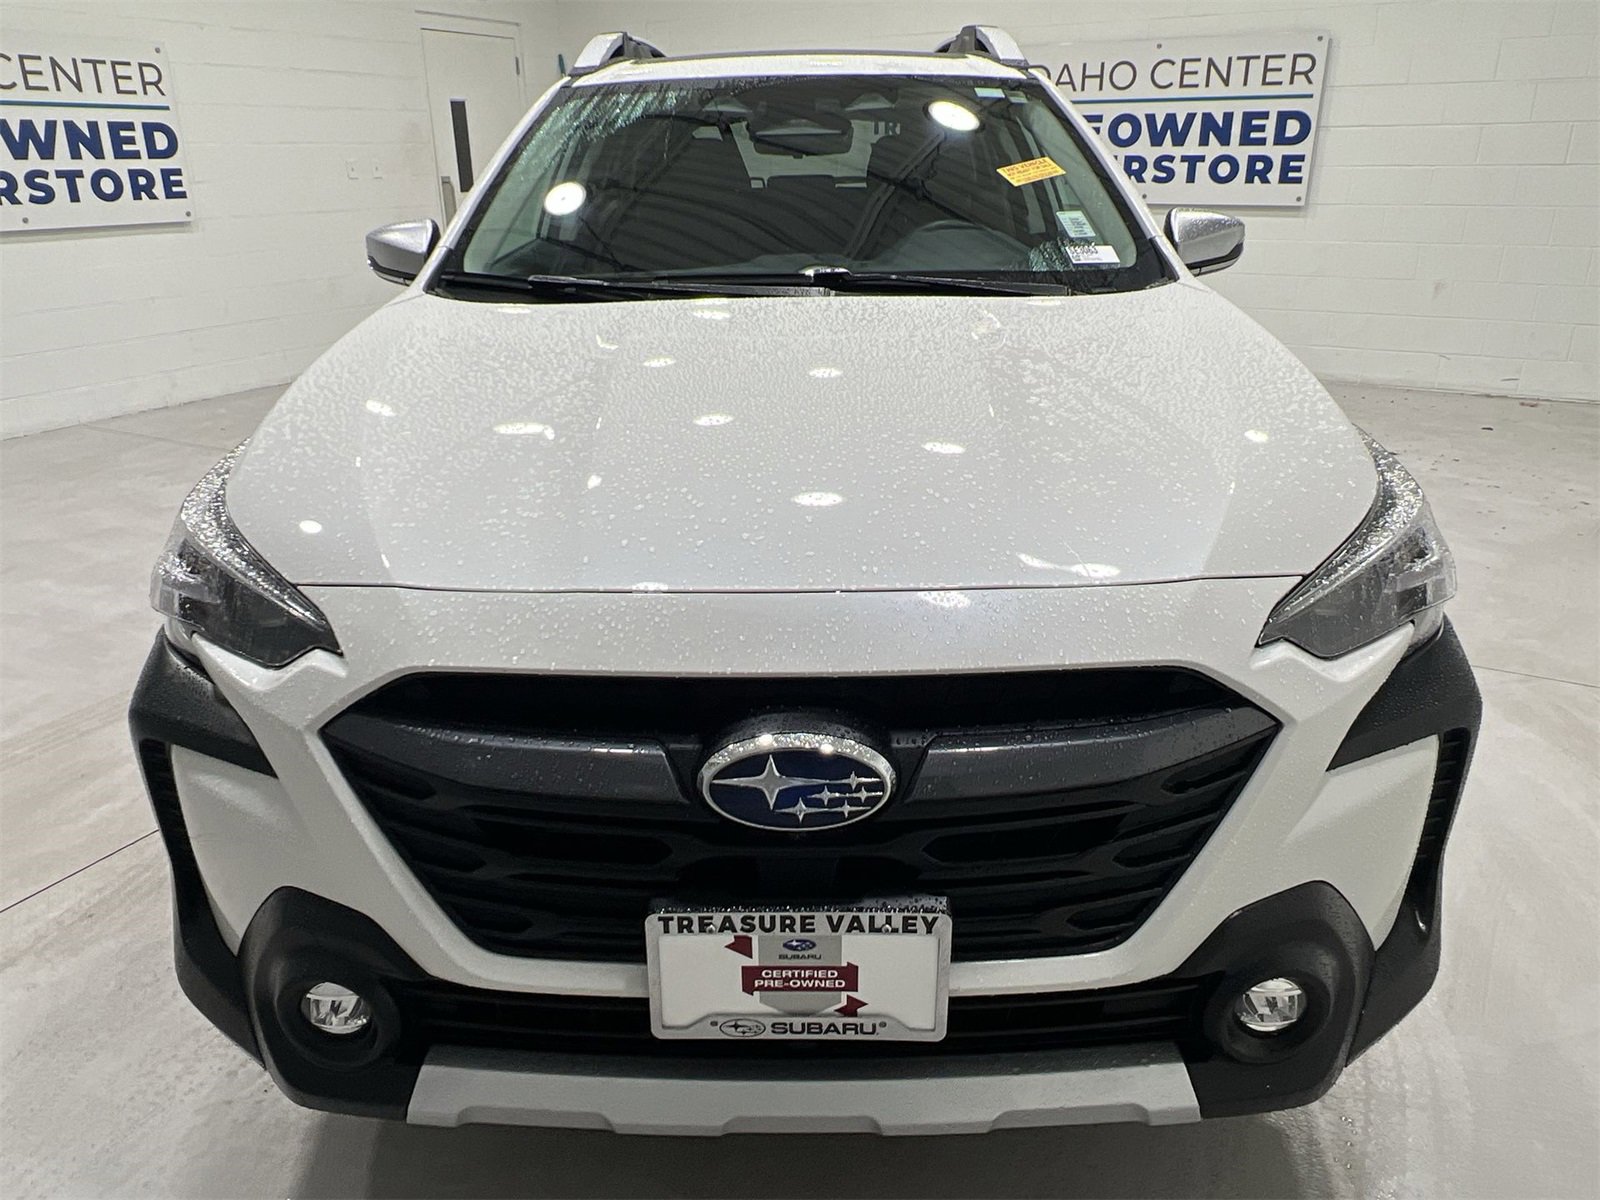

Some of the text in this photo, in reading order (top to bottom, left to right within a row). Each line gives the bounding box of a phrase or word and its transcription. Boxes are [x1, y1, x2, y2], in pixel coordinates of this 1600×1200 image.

[1150, 53, 1317, 90] CENTER
[0, 118, 178, 160] WNED
[658, 915, 939, 934] TREASURE VALLEY
[754, 978, 846, 989] PRE-OWNED
[761, 969, 838, 979] CERTIFIED
